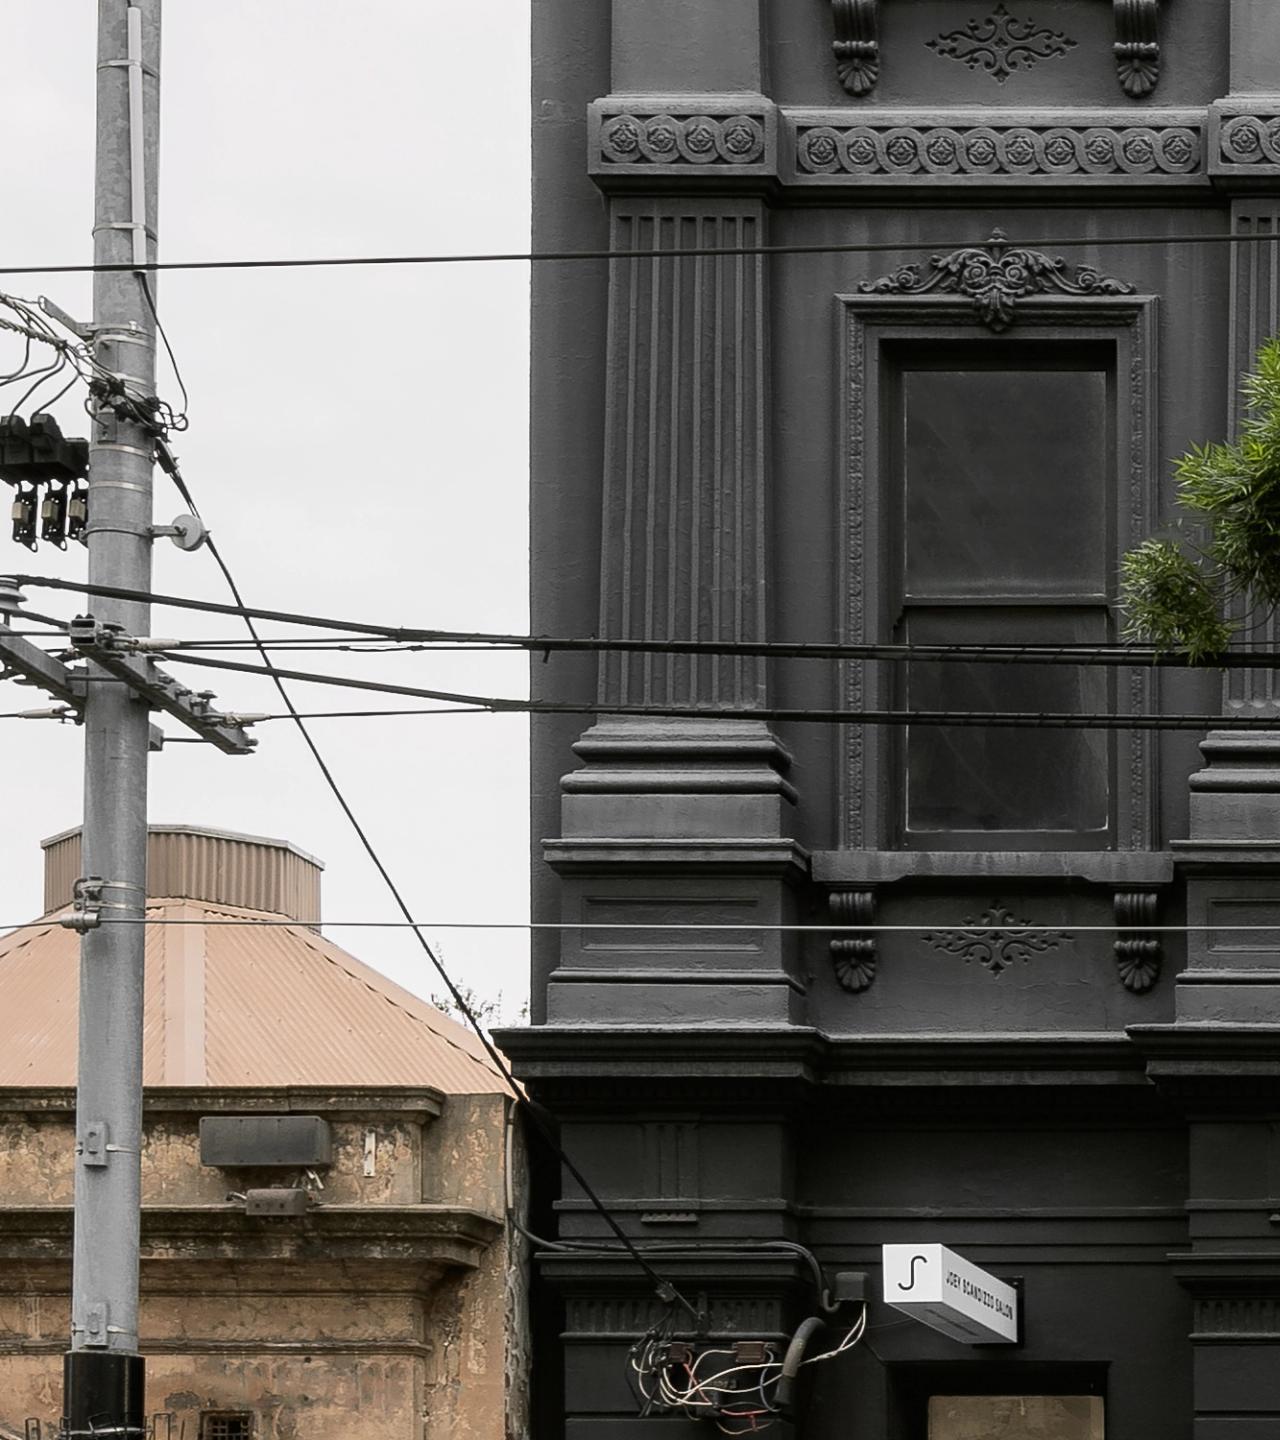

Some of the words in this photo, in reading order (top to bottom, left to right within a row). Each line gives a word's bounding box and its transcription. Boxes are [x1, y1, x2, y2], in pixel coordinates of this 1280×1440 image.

[946, 1271, 961, 1289] JOEY
[962, 1278, 994, 1309] SCANDIZZO
[995, 1298, 1013, 1321] SALON
